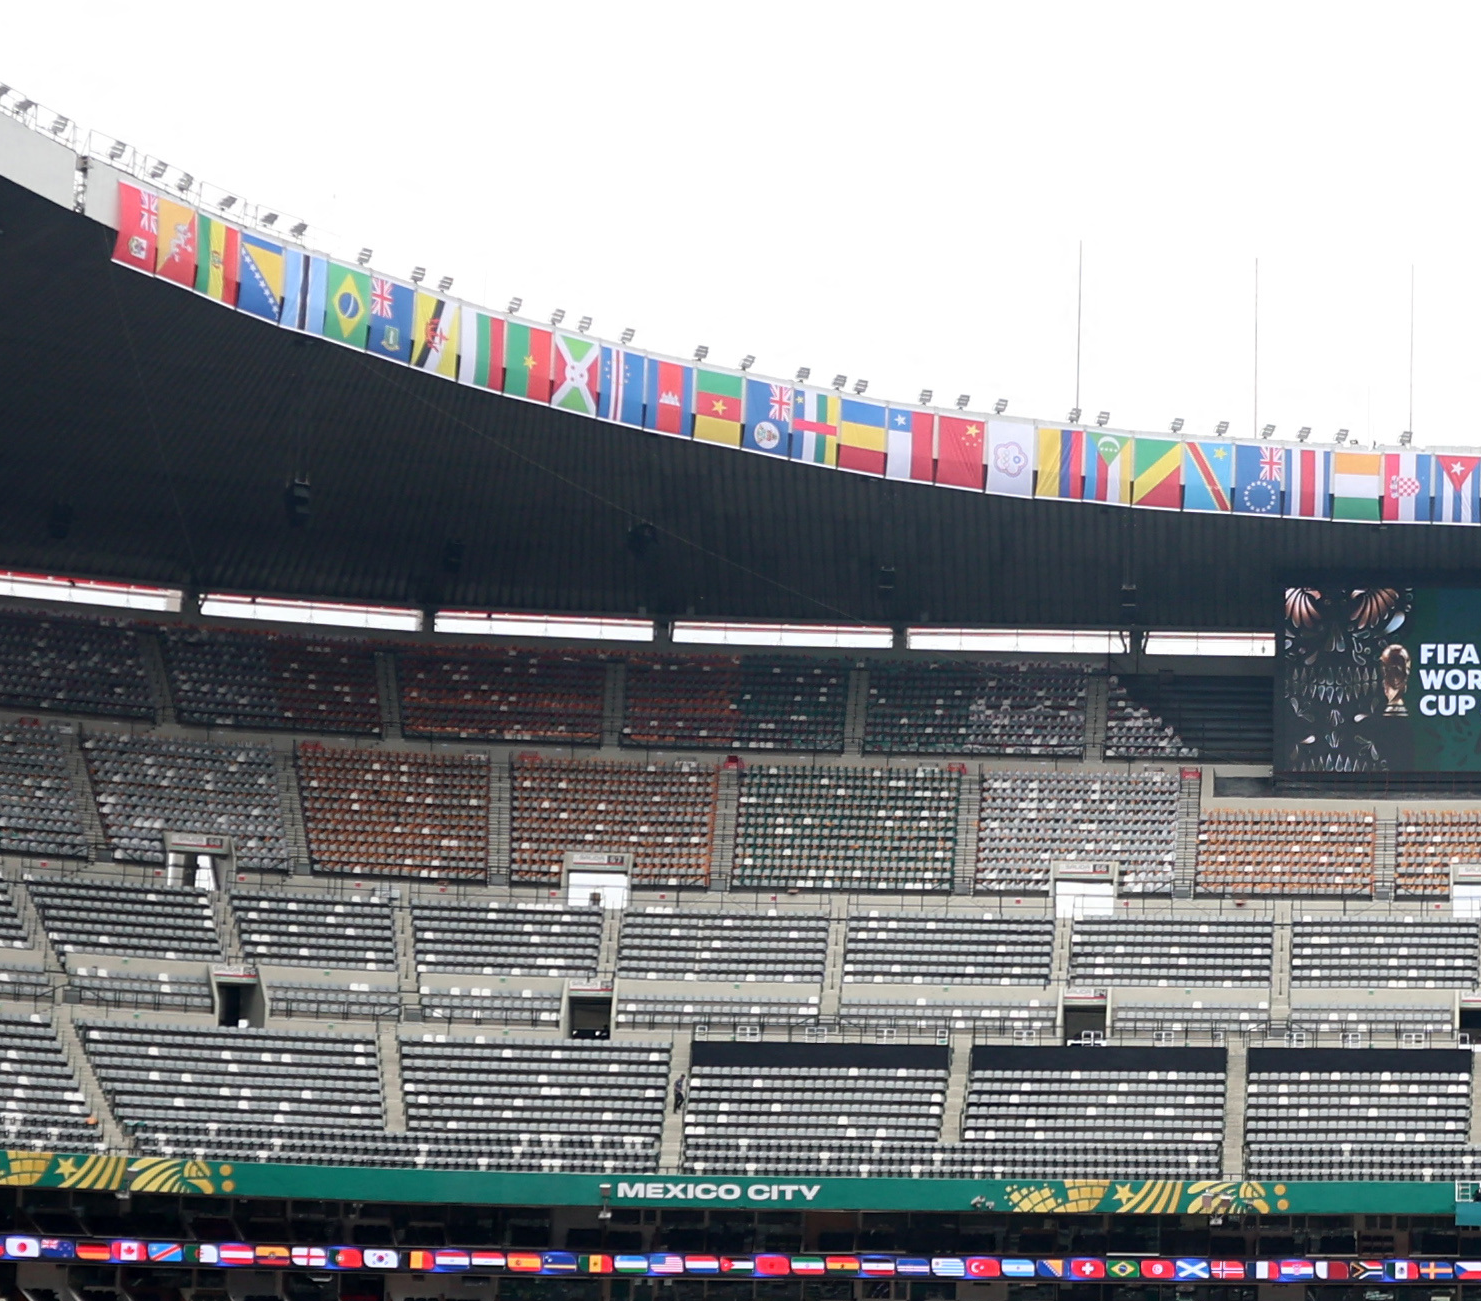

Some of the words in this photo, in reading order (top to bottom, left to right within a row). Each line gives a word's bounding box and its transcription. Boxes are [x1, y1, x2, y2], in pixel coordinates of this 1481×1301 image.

[1420, 643, 1480, 664] FIFA
[1419, 694, 1476, 716] CUP
[617, 1182, 741, 1200] MEXICO
[747, 1184, 821, 1201] CITY
